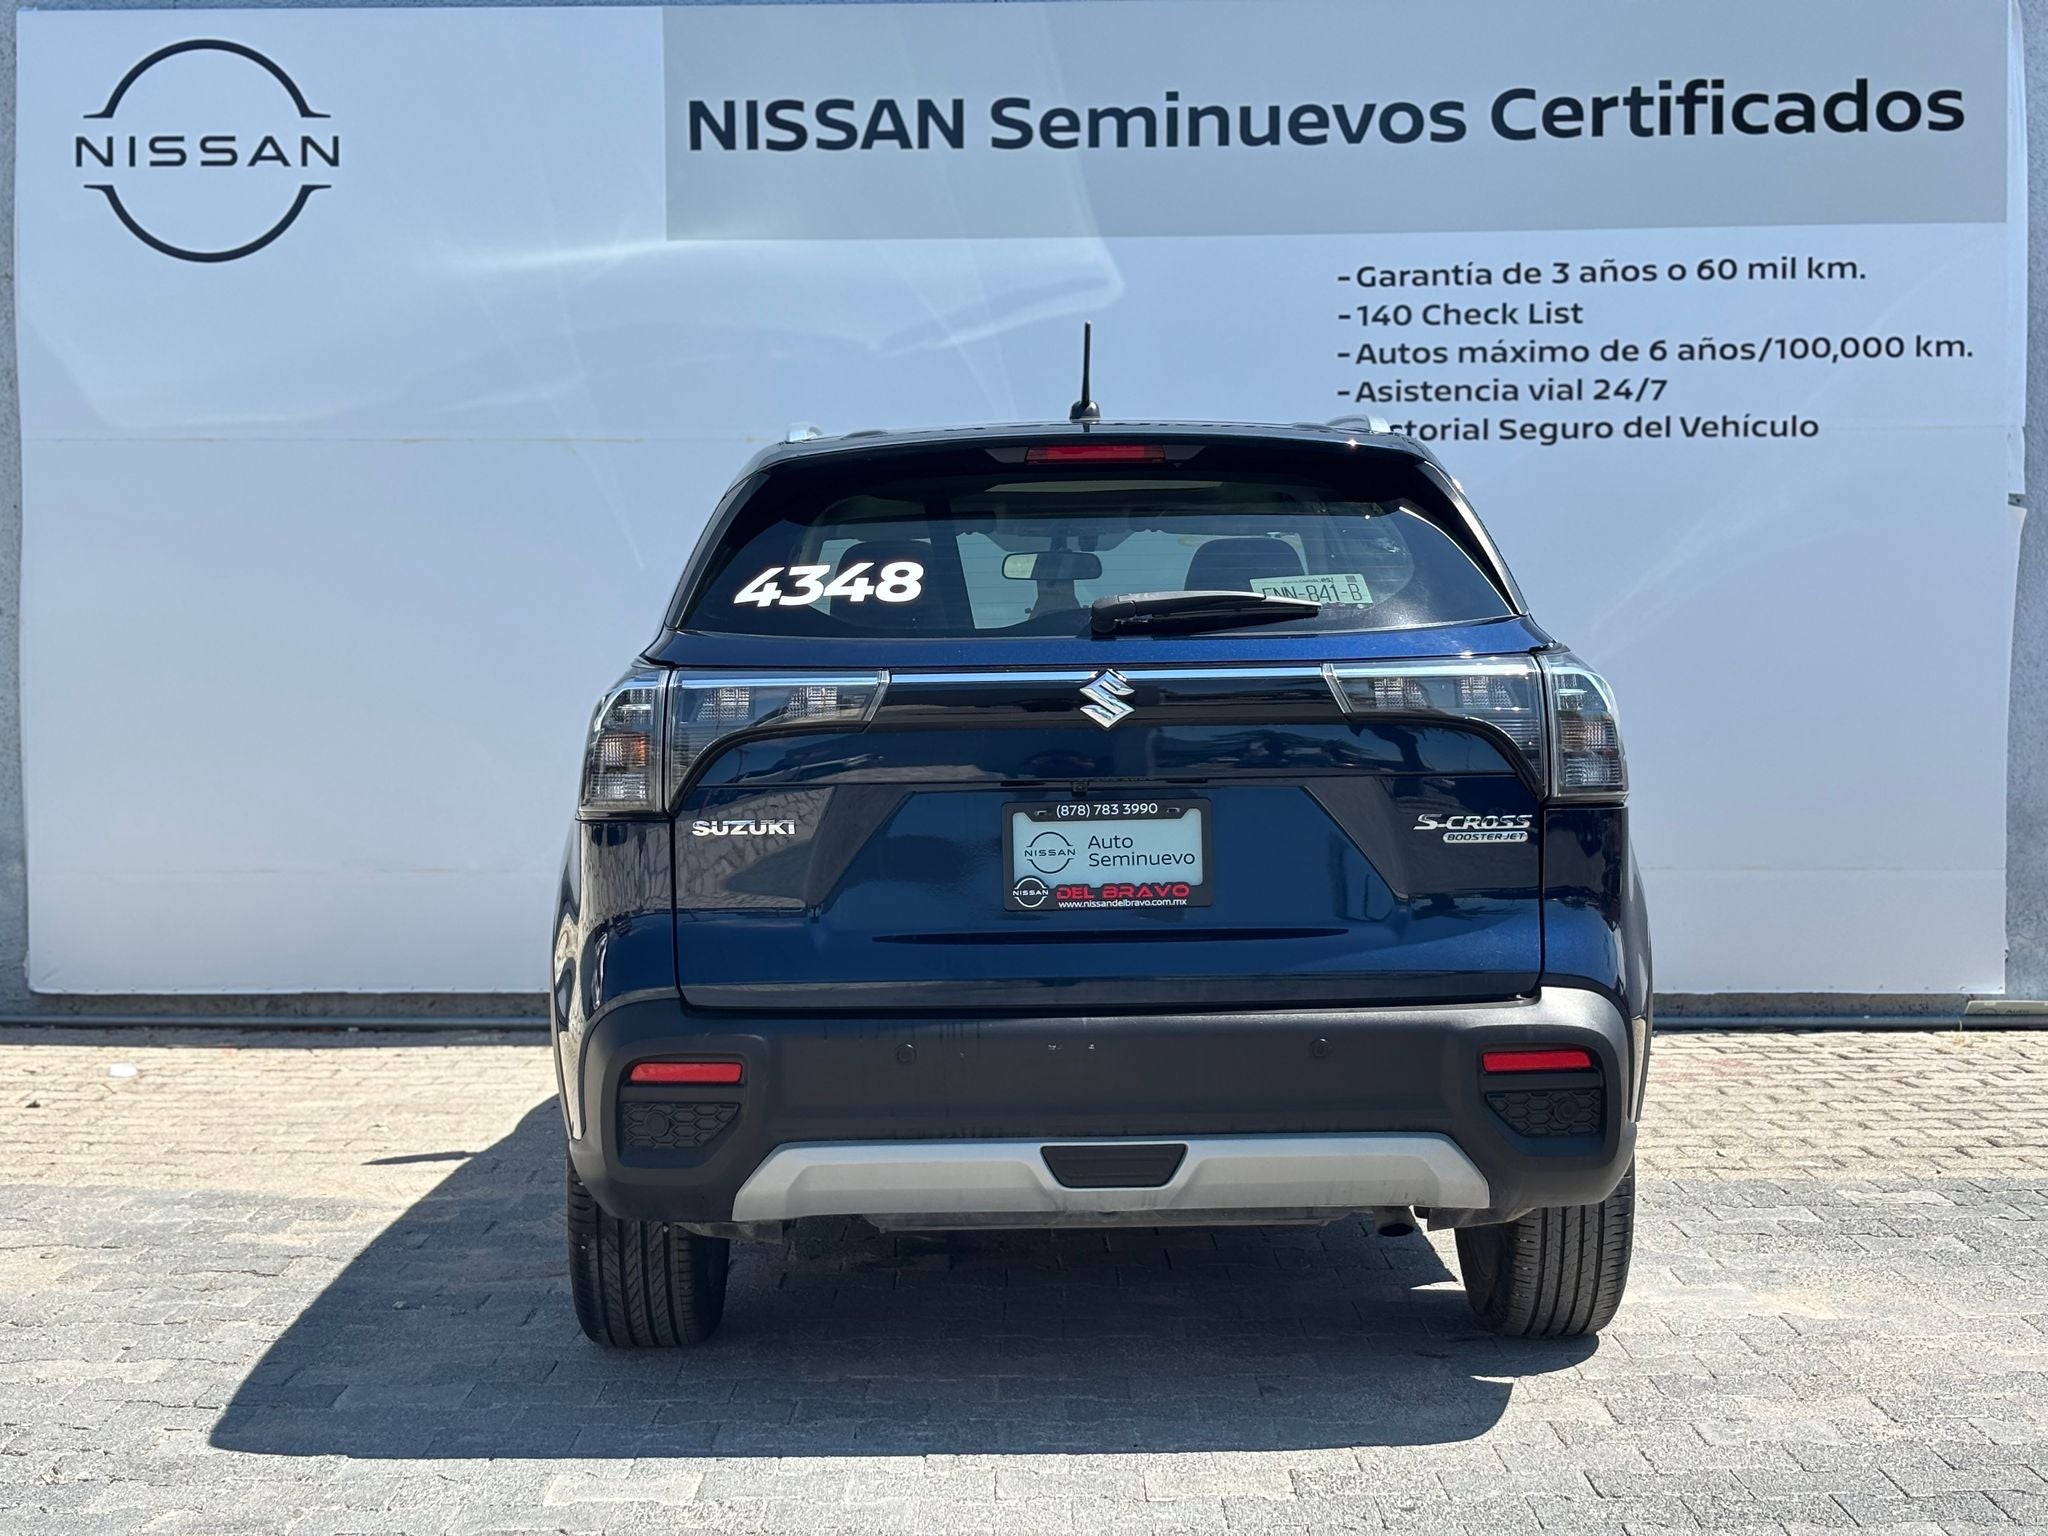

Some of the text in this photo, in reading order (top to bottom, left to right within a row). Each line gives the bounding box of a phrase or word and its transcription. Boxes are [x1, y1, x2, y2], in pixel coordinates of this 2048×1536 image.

[689, 78, 1965, 151] NISSAN Seminuevos Certificados
[75, 135, 340, 167] NISSAN
[1502, 261, 1542, 285] de
[1551, 262, 1570, 284] 3
[1579, 259, 1658, 284] años
[1667, 263, 1687, 282] o
[1696, 258, 1738, 281] 60
[1748, 255, 1797, 280] mil
[1807, 256, 1867, 280] km.
[1421, 302, 1519, 326] Check
[1528, 300, 1584, 325] List
[1458, 338, 1590, 364] máximo
[1599, 338, 1640, 363] de
[1649, 339, 1668, 362] 6
[1677, 336, 1905, 364] años/100,000
[1915, 335, 1974, 359] km.
[1528, 377, 1583, 402] vial
[1593, 377, 1668, 403] 24/7
[1498, 418, 1614, 447] Seguro
[1623, 415, 1671, 439] del
[1679, 413, 1820, 438] Vehículo
[733, 561, 925, 608] 4348
[1056, 802, 1158, 818] (878) 783 3990
[691, 819, 797, 837] SUZUKI
[1412, 813, 1533, 830] S-CROSS
[1087, 835, 1134, 850] Auto
[1446, 832, 1525, 841] BOOSTERJET
[1024, 848, 1076, 857] NISSAN
[1088, 852, 1196, 867] Seminuevo
[1012, 888, 1049, 896] NISSAN
[1056, 884, 1190, 900] DEL BRAVO
[1058, 898, 1188, 909] www.nissandelbravo.com.mx
